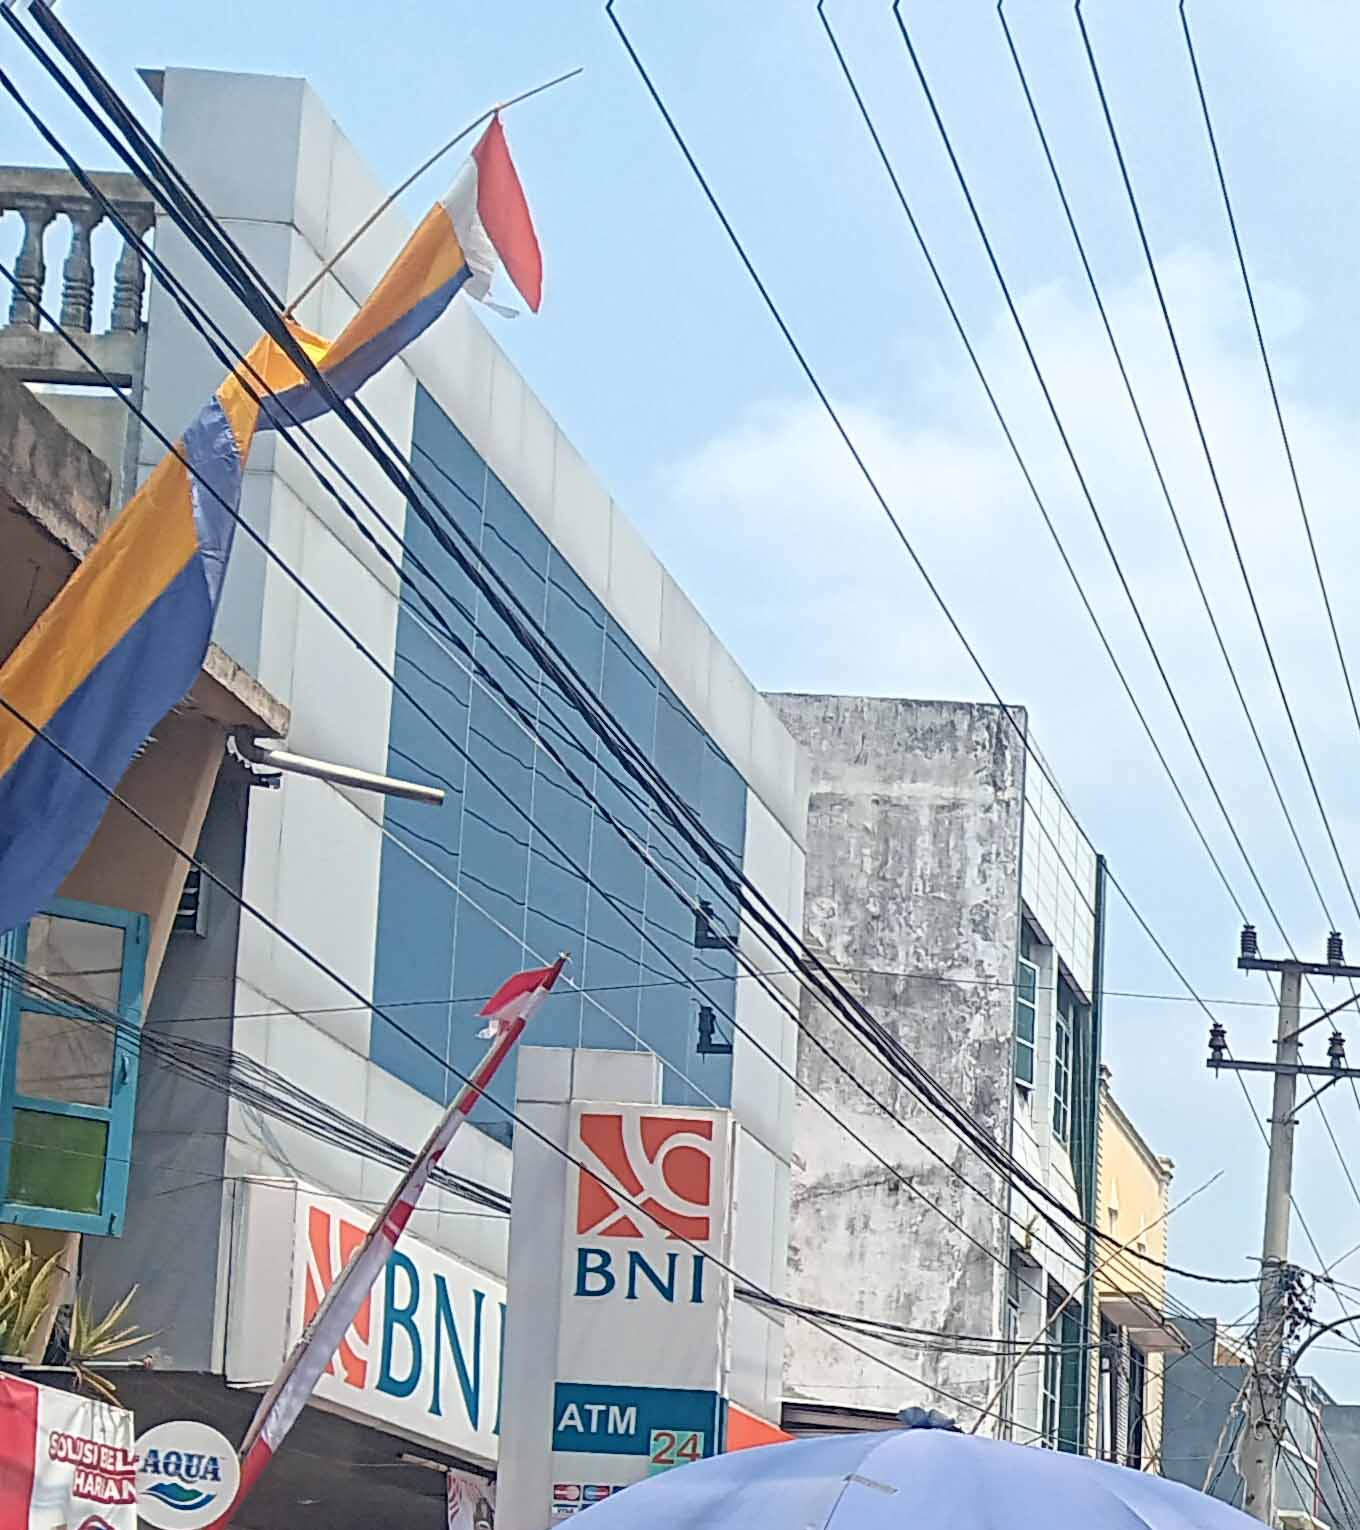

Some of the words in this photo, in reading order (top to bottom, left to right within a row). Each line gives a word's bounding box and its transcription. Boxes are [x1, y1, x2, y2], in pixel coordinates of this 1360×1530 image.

[574, 1247, 705, 1303] BNI
[375, 1249, 507, 1436] BNI
[557, 1403, 638, 1435] ATM
[652, 1432, 700, 1464] 24
[139, 1449, 222, 1484] AQUA
